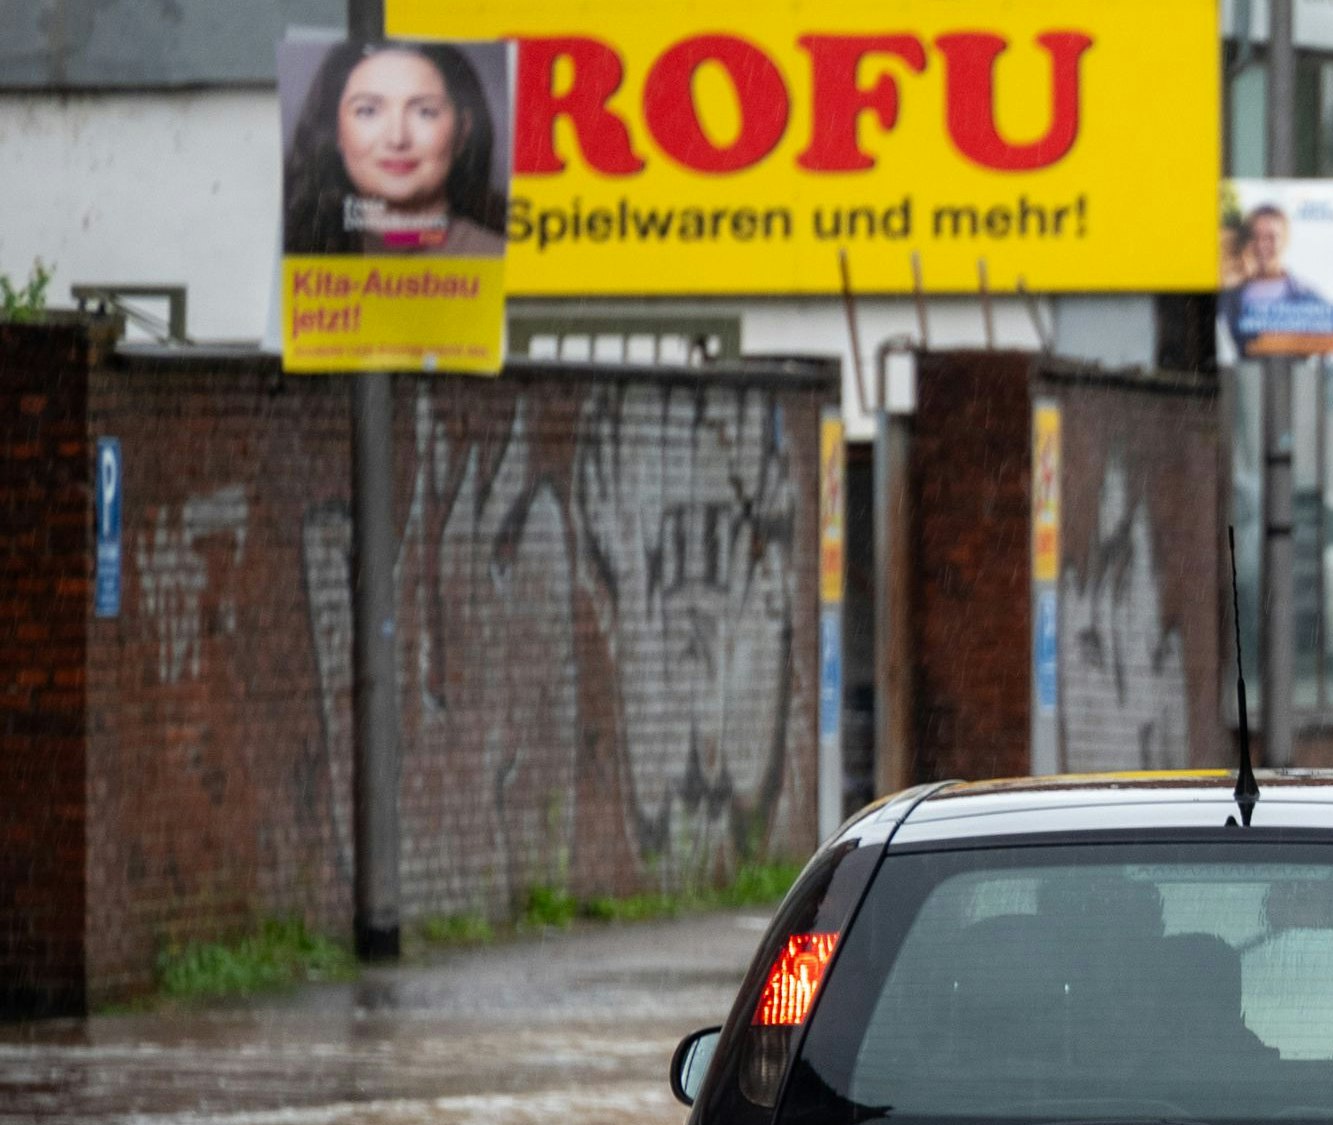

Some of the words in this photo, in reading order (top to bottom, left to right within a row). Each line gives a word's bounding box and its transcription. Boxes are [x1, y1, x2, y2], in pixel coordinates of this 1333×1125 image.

[513, 30, 1094, 177] ROFU
[505, 197, 792, 251] Spielwaren
[813, 197, 911, 241] und
[931, 195, 1087, 240] mehr!
[293, 266, 480, 299] Kita-Ausbau
[291, 303, 361, 341] jetzt!
